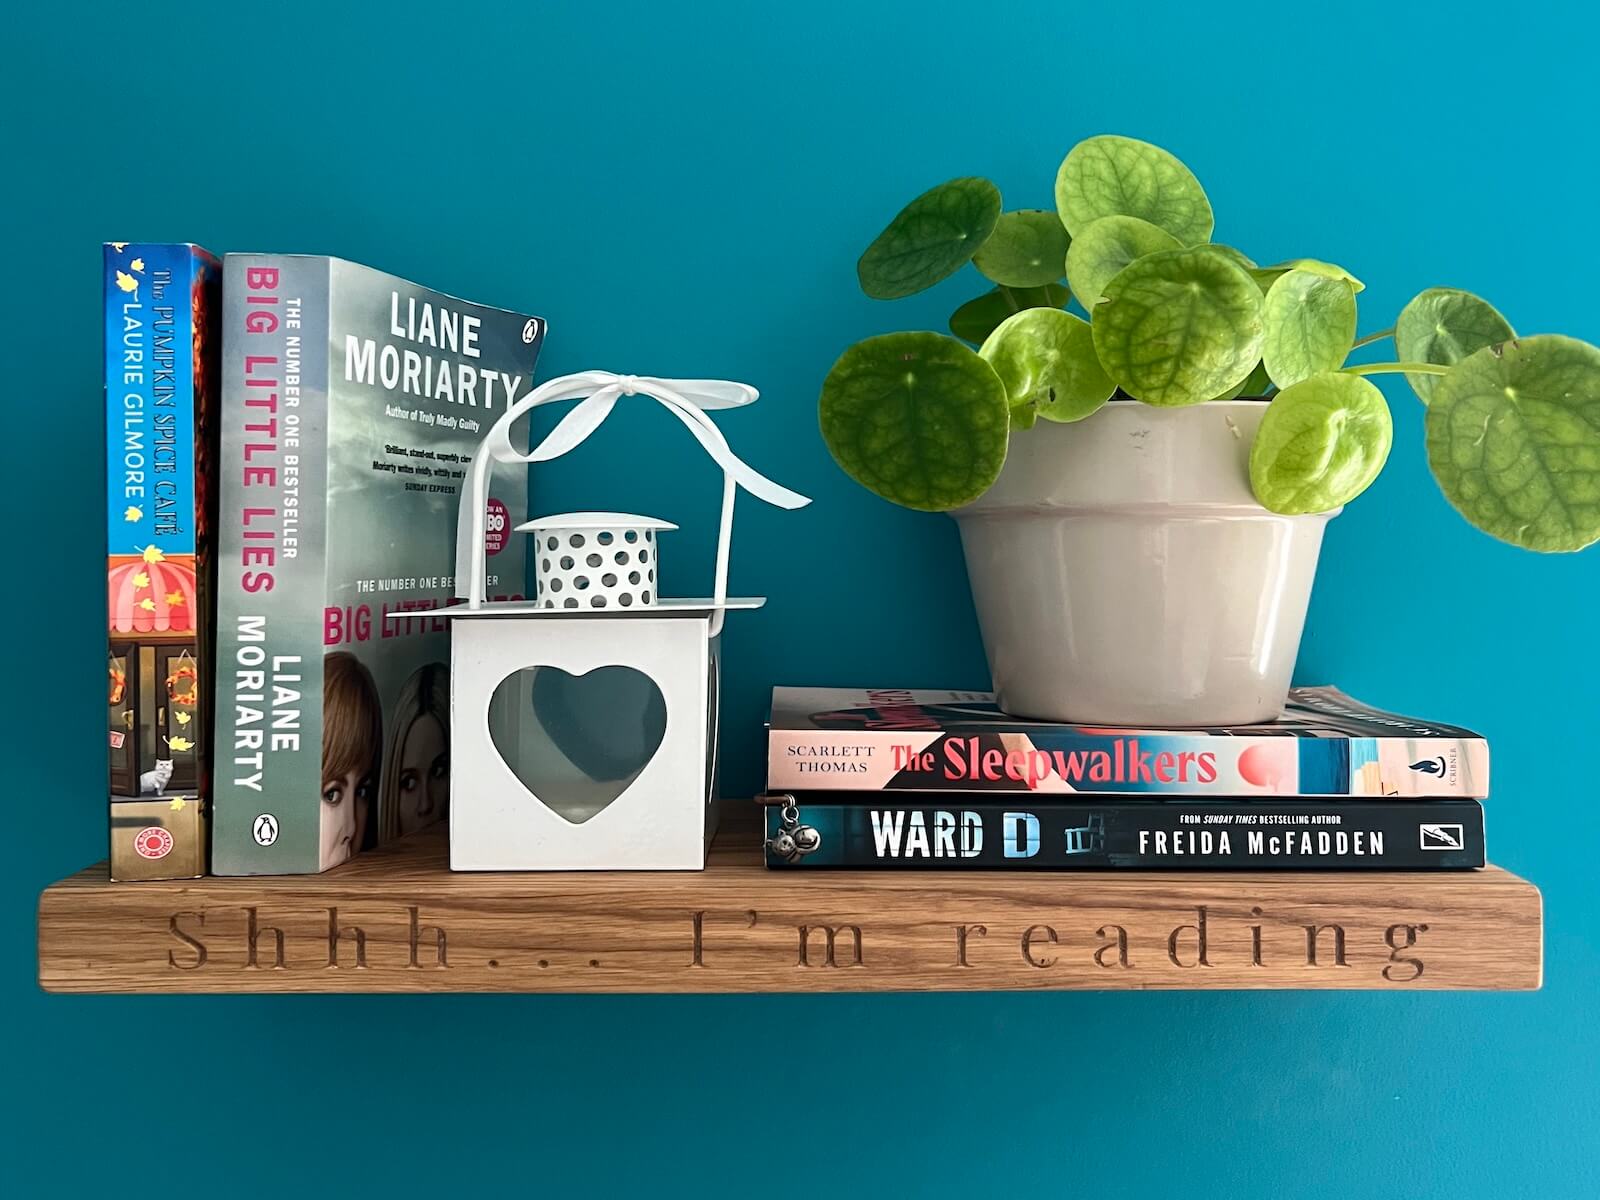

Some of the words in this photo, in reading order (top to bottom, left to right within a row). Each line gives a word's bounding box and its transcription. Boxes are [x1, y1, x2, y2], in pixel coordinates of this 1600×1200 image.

[153, 270, 171, 300] The
[246, 267, 280, 334] BIG
[286, 297, 301, 330] THE
[390, 291, 481, 359] LIANE
[123, 303, 144, 385] LAURIE
[153, 305, 176, 407] PUMPKIN
[284, 336, 300, 408] NUMBER
[344, 334, 522, 412] MORIARTY
[154, 413, 176, 474] SPICE
[243, 356, 278, 488] LITTLE
[283, 414, 299, 449] ONE
[385, 403, 410, 420] Author
[410, 409, 418, 421] of
[419, 410, 436, 427] Truly
[436, 414, 458, 430] Madly
[458, 417, 480, 433] Guilty
[123, 394, 145, 499] GILMORE
[154, 480, 184, 536] CAFÉ
[283, 455, 299, 559] BESTSELLER
[405, 482, 428, 492] SUNDAY
[429, 484, 456, 495] EXPRESS
[241, 508, 277, 593] LIES
[487, 514, 505, 532] BO
[357, 580, 375, 593] THE
[377, 577, 416, 592] NUMBER
[419, 576, 438, 590] ONE
[323, 604, 372, 646] BIG
[234, 615, 266, 792] MORIARTY
[271, 655, 302, 752] LIANE
[787, 744, 876, 758] SCARLETT
[795, 760, 868, 774] THOMAS
[890, 743, 936, 772] The
[943, 735, 1217, 791] Sleepwalkers
[1449, 747, 1457, 787] SCRIBNER
[870, 810, 984, 858] WARD
[1002, 811, 1041, 859] D
[1138, 830, 1232, 856] FREIDA
[1248, 830, 1384, 856] McFADDEN
[1179, 814, 1201, 824] FROM
[1202, 814, 1233, 825] SUNDAY
[1234, 814, 1257, 825] TIMES
[1259, 815, 1309, 825] BESTSELLING
[1311, 815, 1342, 825] AUTHOR
[686, 908, 866, 970] I'm
[949, 905, 1430, 983] reading
